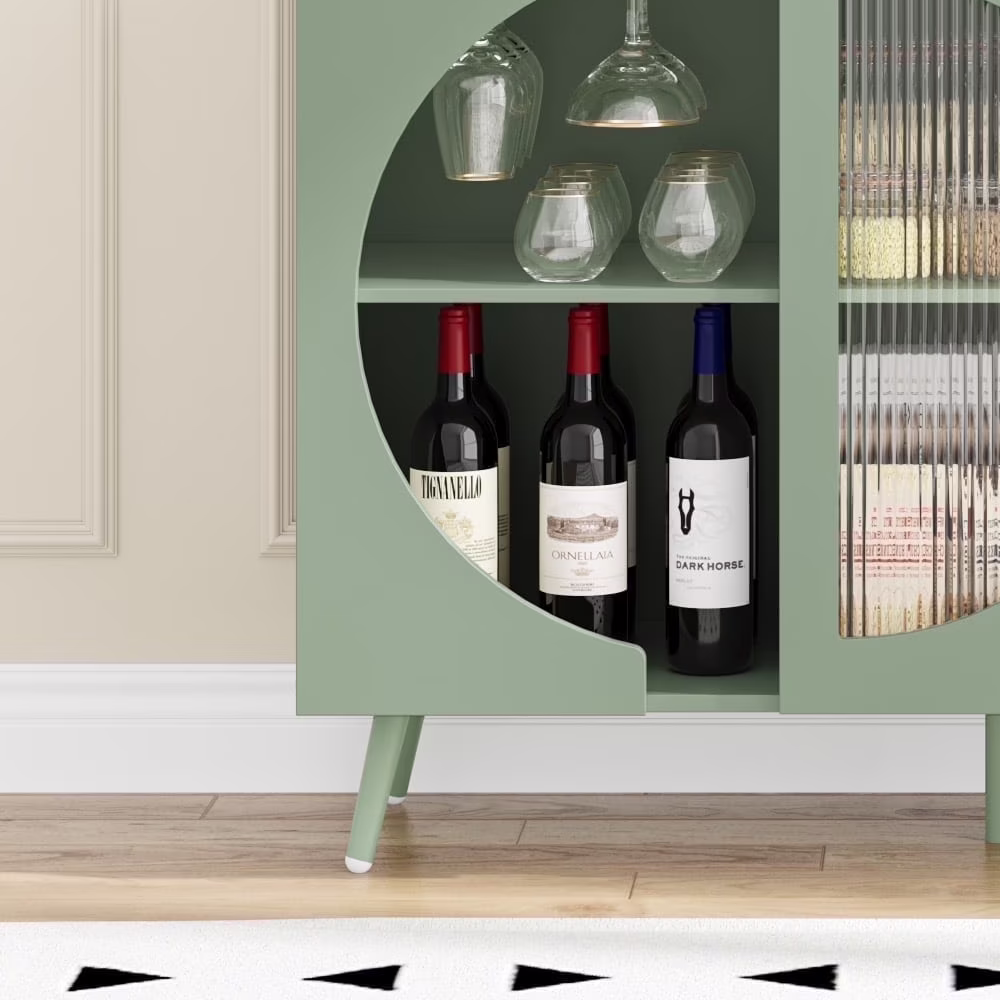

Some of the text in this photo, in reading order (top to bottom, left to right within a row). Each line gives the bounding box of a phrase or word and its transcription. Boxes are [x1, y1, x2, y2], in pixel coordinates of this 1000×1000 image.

[421, 474, 482, 500] TIGNANELLO
[551, 550, 615, 561] ORNELLAIA
[676, 559, 744, 571] DARK HORSE
